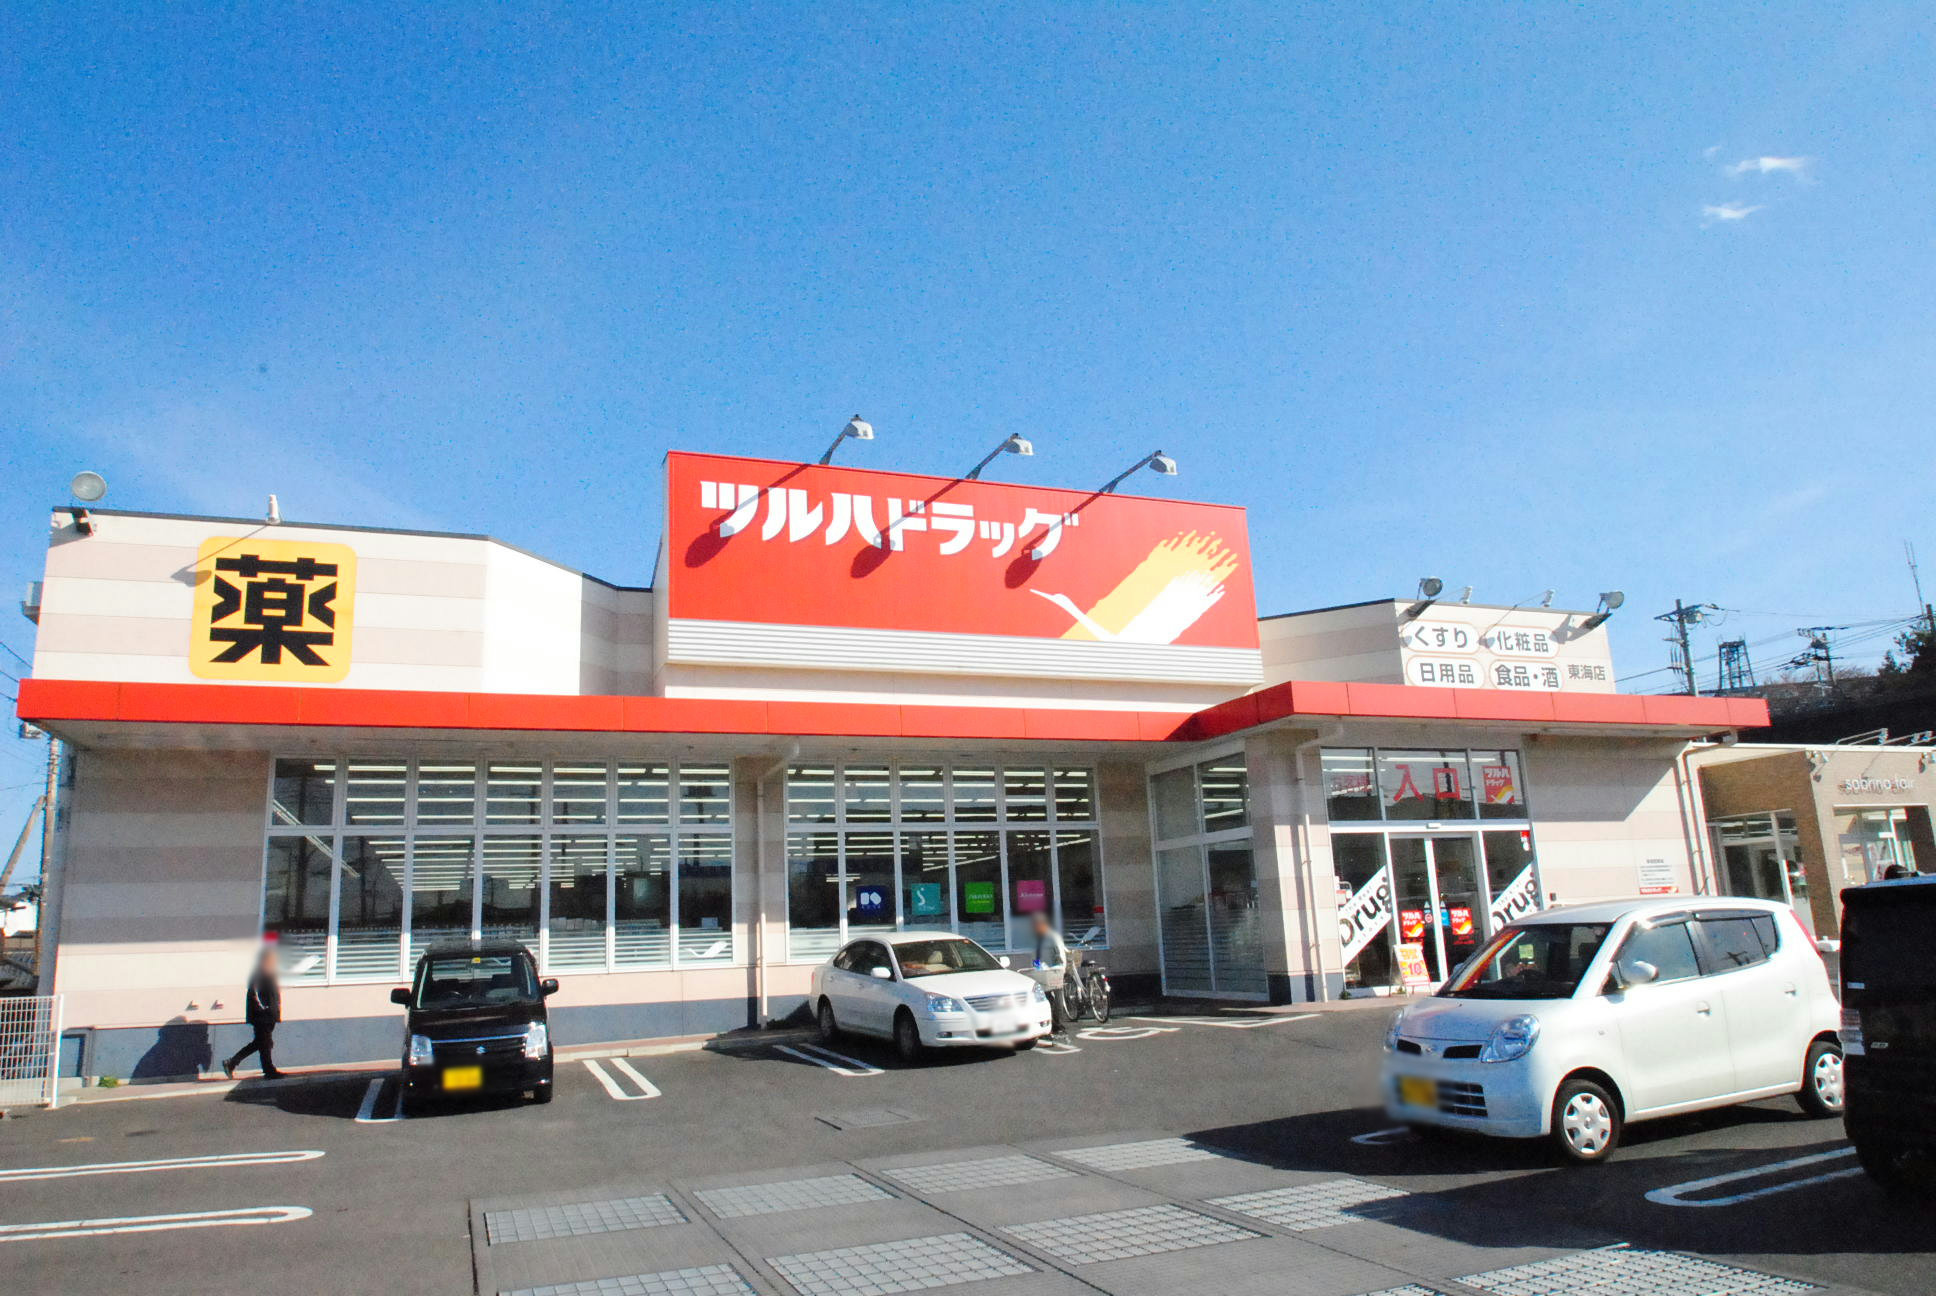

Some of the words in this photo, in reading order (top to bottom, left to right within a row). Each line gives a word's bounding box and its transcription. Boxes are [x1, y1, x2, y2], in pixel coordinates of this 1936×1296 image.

[701, 481, 1079, 560] ツルハドラッグ
[209, 554, 338, 667] 薬
[1414, 626, 1468, 649] くすり
[1498, 631, 1550, 653] 化粧品
[1420, 662, 1475, 685] 日用品
[1494, 664, 1560, 689] 食品・酒
[1567, 664, 1607, 681] 東海店
[1393, 764, 1461, 802] 入口
[1484, 767, 1510, 779] ツルハ
